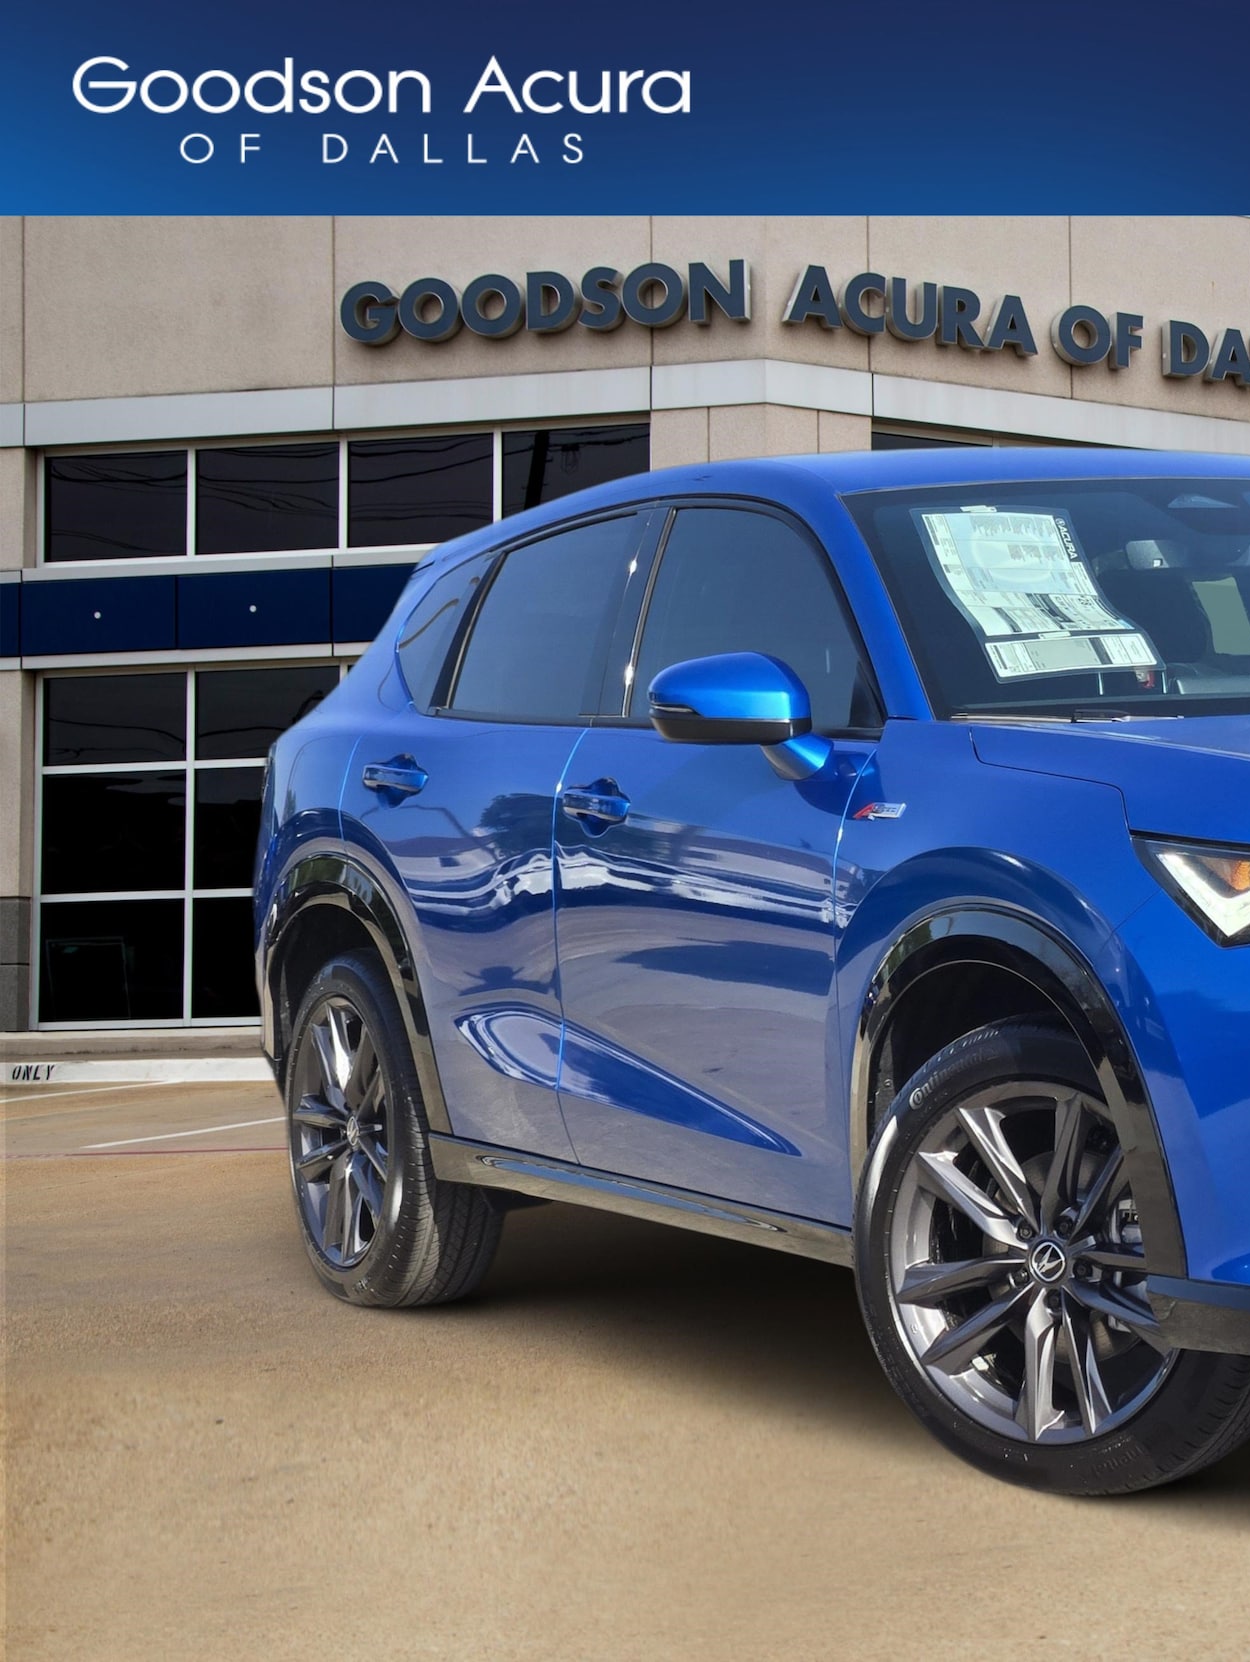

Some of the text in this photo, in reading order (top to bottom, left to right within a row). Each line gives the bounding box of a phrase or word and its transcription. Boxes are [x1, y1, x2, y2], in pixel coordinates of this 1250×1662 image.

[340, 258, 751, 346] GOODSON
[782, 264, 1038, 357] ACURA
[1050, 304, 1145, 371] OF
[1058, 525, 1078, 560] ACURA
[11, 1064, 55, 1081] ONLY
